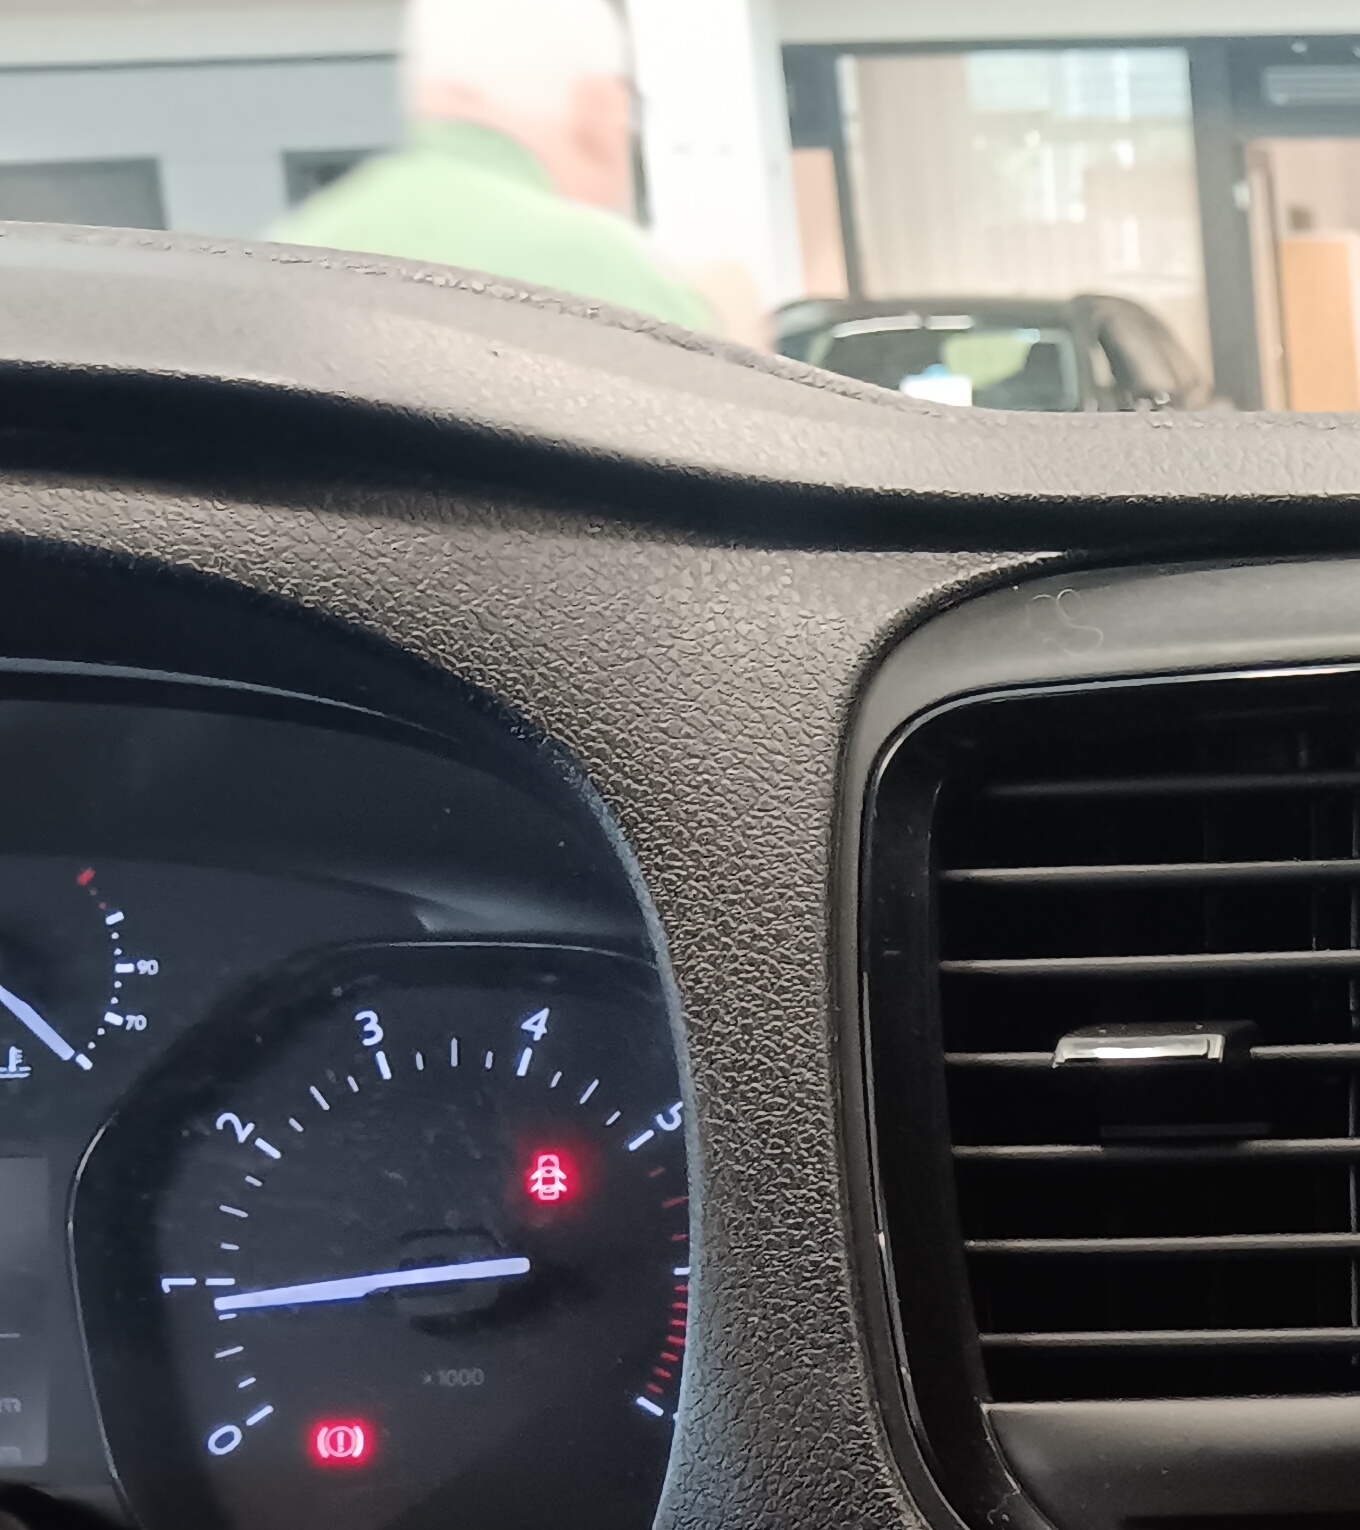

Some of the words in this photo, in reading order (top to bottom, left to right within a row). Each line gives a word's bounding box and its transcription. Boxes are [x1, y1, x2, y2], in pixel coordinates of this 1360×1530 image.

[136, 959, 159, 976] 90
[125, 1014, 147, 1031] 70
[354, 1010, 384, 1047] 3
[520, 1007, 550, 1042] 4
[215, 1112, 256, 1145] 2
[654, 1101, 684, 1132] 5
[161, 1277, 197, 1294] 1
[207, 1424, 243, 1456] 0
